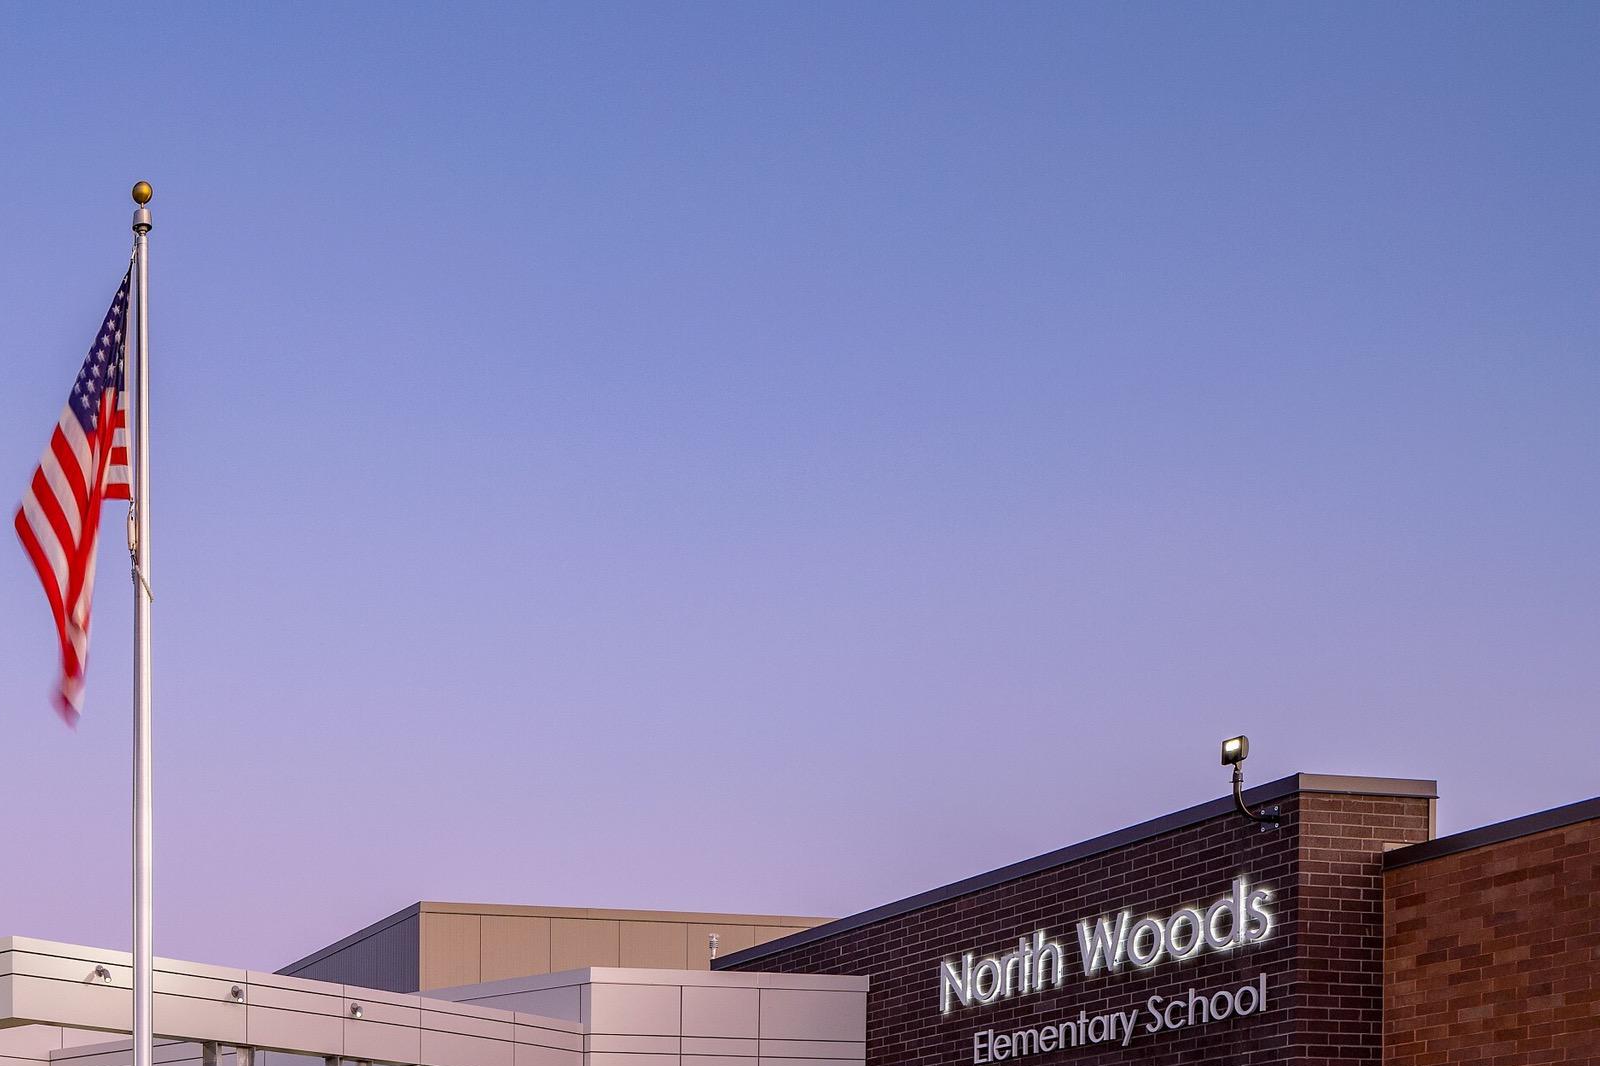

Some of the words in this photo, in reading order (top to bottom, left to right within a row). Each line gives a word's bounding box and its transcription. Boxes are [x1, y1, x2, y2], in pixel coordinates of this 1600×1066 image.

[939, 932, 1063, 1013] North
[1076, 876, 1271, 977] Woods
[973, 1009, 1139, 1065] Elementary
[1146, 972, 1267, 1034] School
